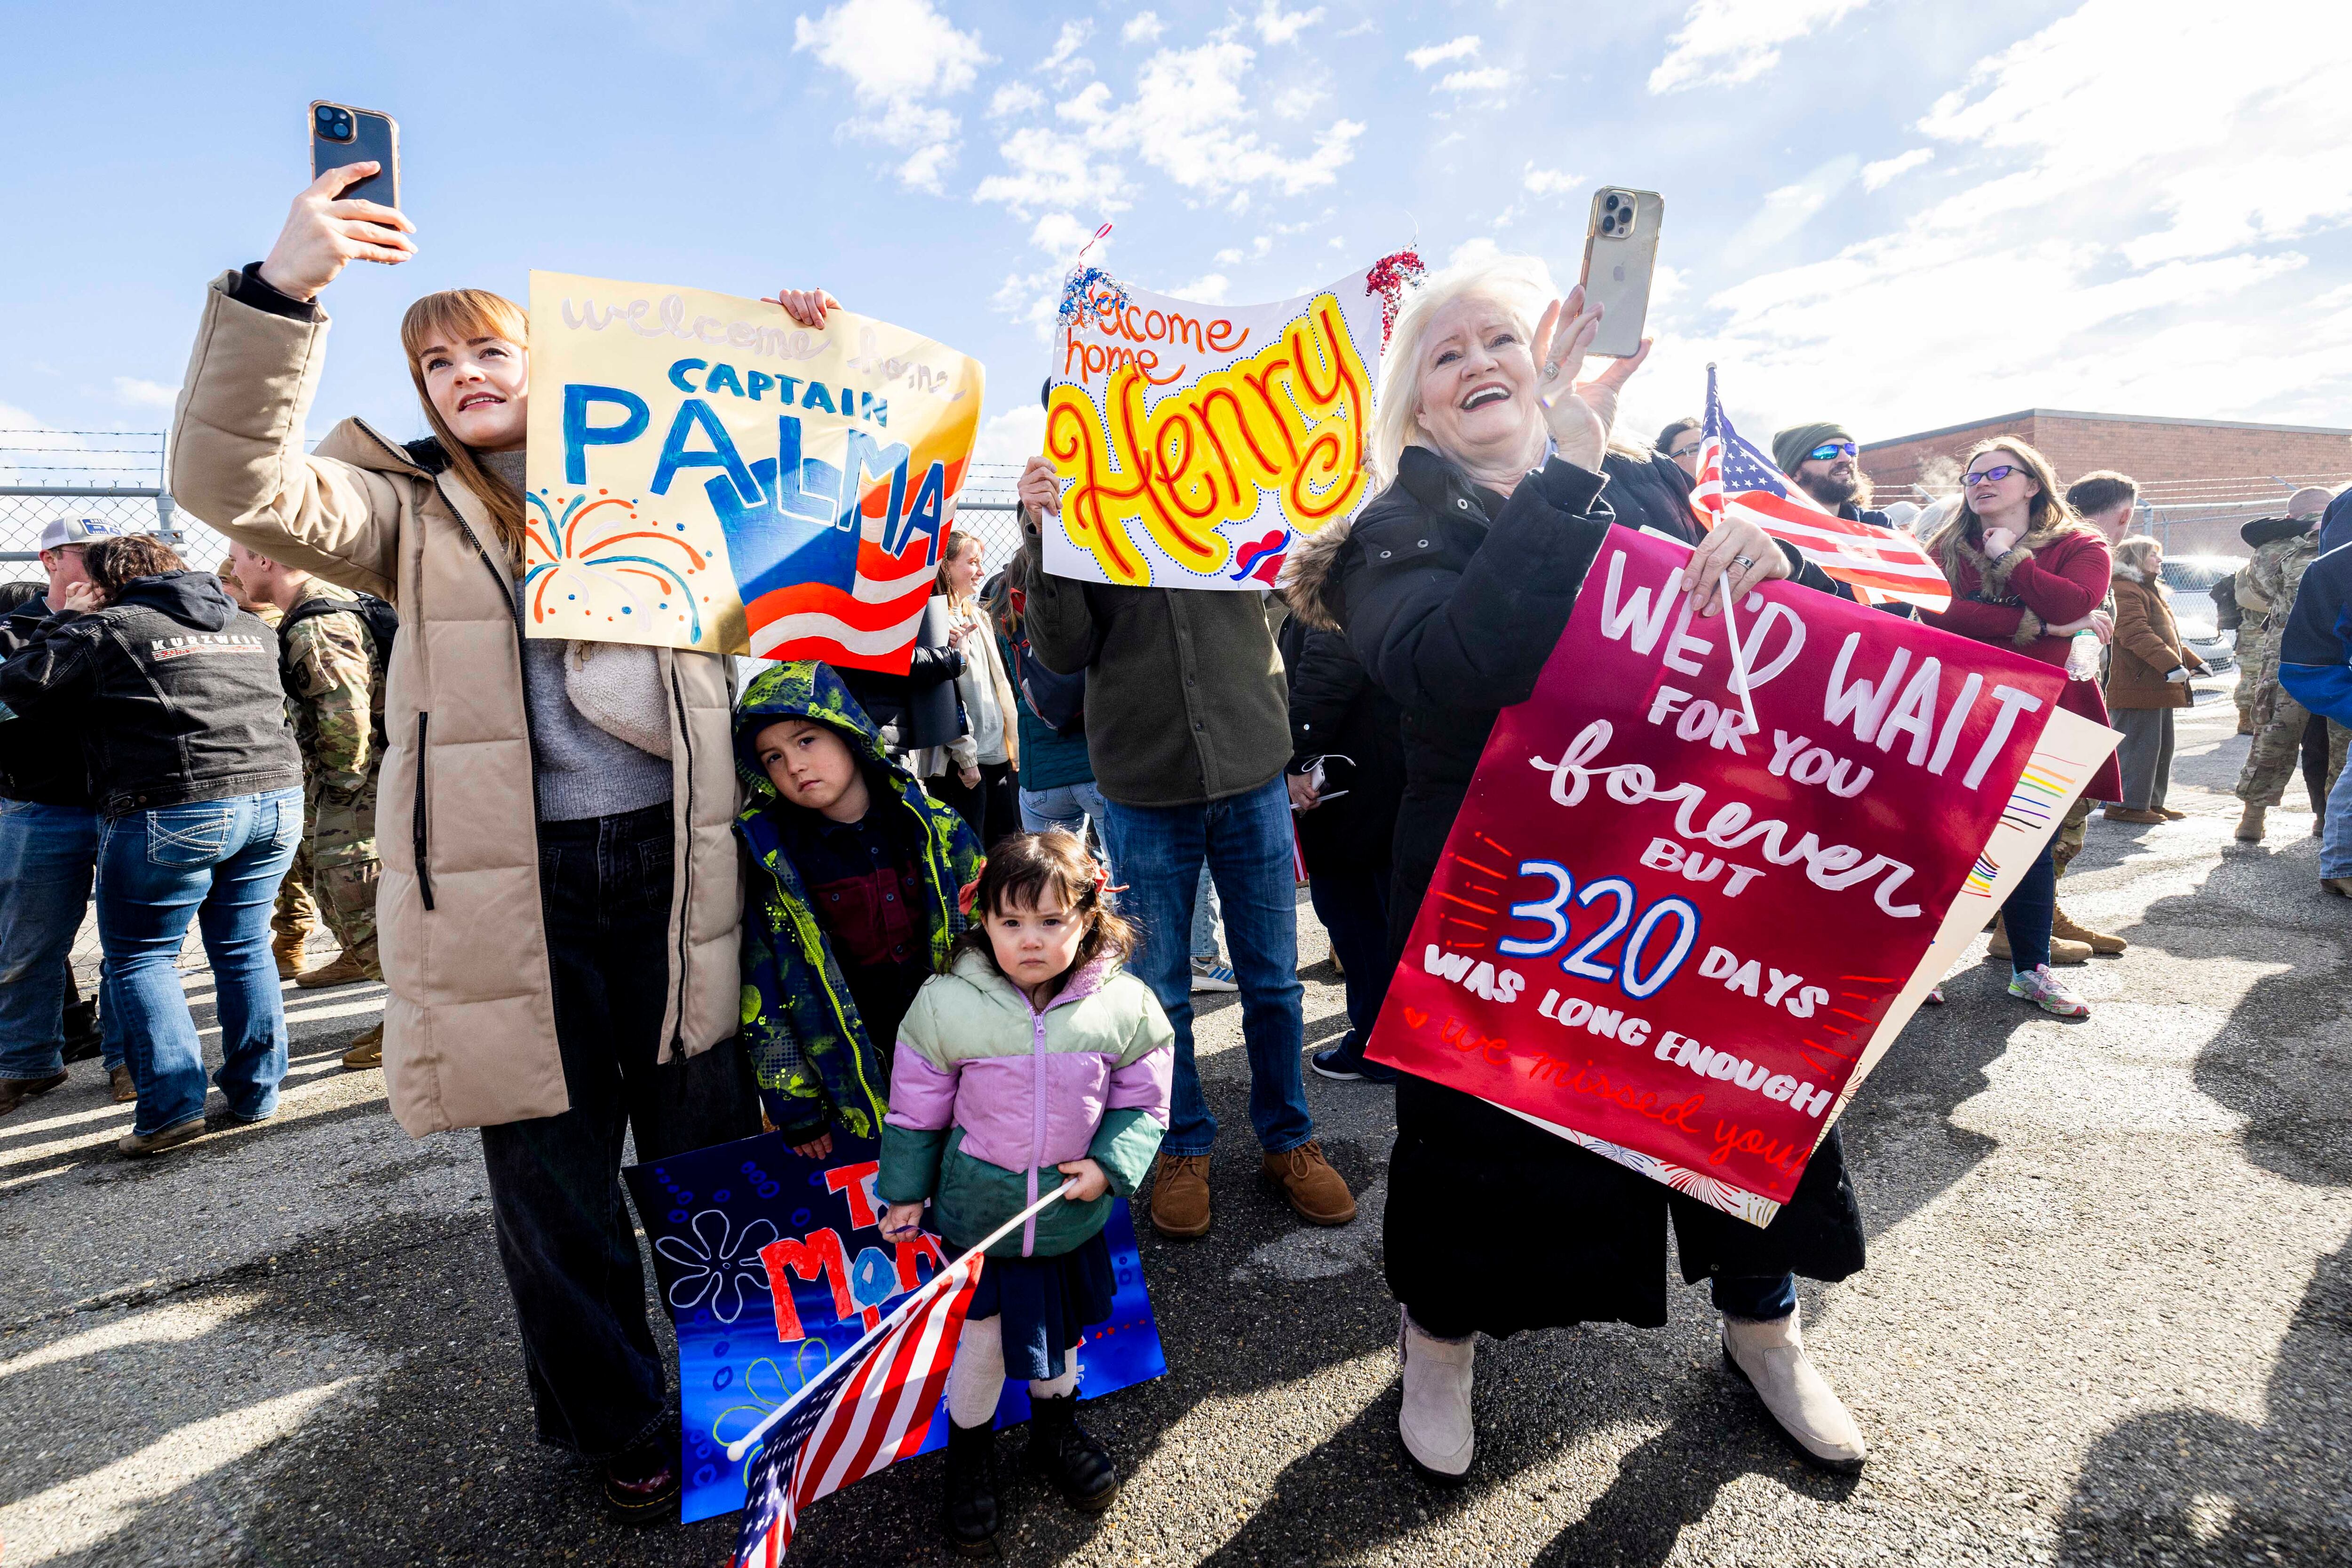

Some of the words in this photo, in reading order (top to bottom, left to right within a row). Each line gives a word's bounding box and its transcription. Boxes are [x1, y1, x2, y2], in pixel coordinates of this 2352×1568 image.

[561, 293, 833, 361] welcome
[847, 326, 966, 402] home
[668, 358, 888, 428] CAPTAIN
[1065, 327, 1186, 386] home
[561, 382, 945, 567] PALMA
[1043, 293, 1373, 586] Henry
[151, 635, 262, 650] KURZWEIL
[1600, 549, 1807, 697] WE'D
[1824, 632, 2043, 790] WAIT
[1647, 685, 1755, 755] FOR
[1772, 729, 1874, 798] YOU
[1529, 719, 1923, 918] forever
[1640, 837, 1767, 898] BUT
[1496, 858, 1704, 1001] 320
[1698, 945, 1829, 1020] DAYS
[1423, 944, 1526, 1004] WAS
[1538, 988, 1652, 1047] LONG
[1653, 1031, 1834, 1118] ENOUGH
[1441, 1017, 1508, 1067] we
[1530, 1050, 1701, 1135] missed
